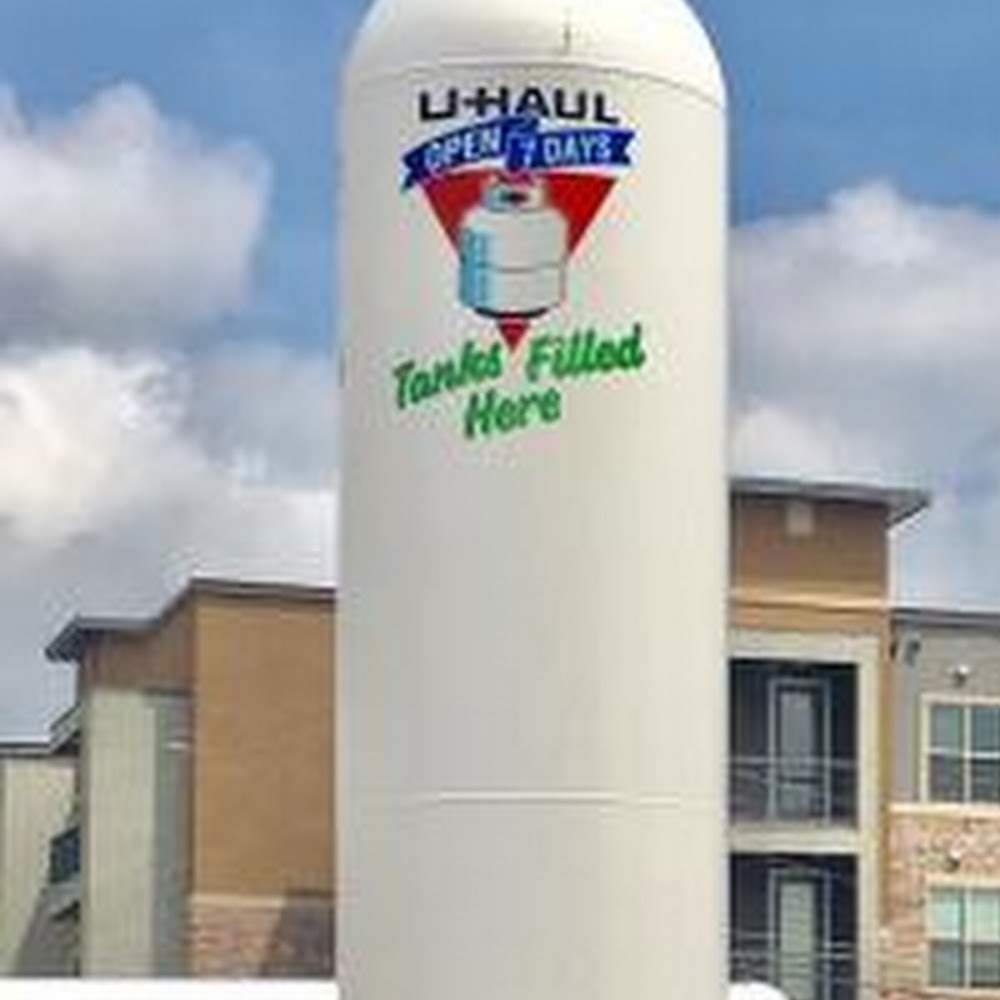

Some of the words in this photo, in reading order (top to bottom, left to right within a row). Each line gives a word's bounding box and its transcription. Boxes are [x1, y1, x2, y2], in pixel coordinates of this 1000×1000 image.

[419, 85, 620, 124] U-HAUL
[424, 126, 499, 170] OPEN
[543, 131, 612, 163] DAYS
[393, 340, 503, 409] Tanks
[525, 322, 646, 382] Filled
[464, 386, 562, 439] Here
